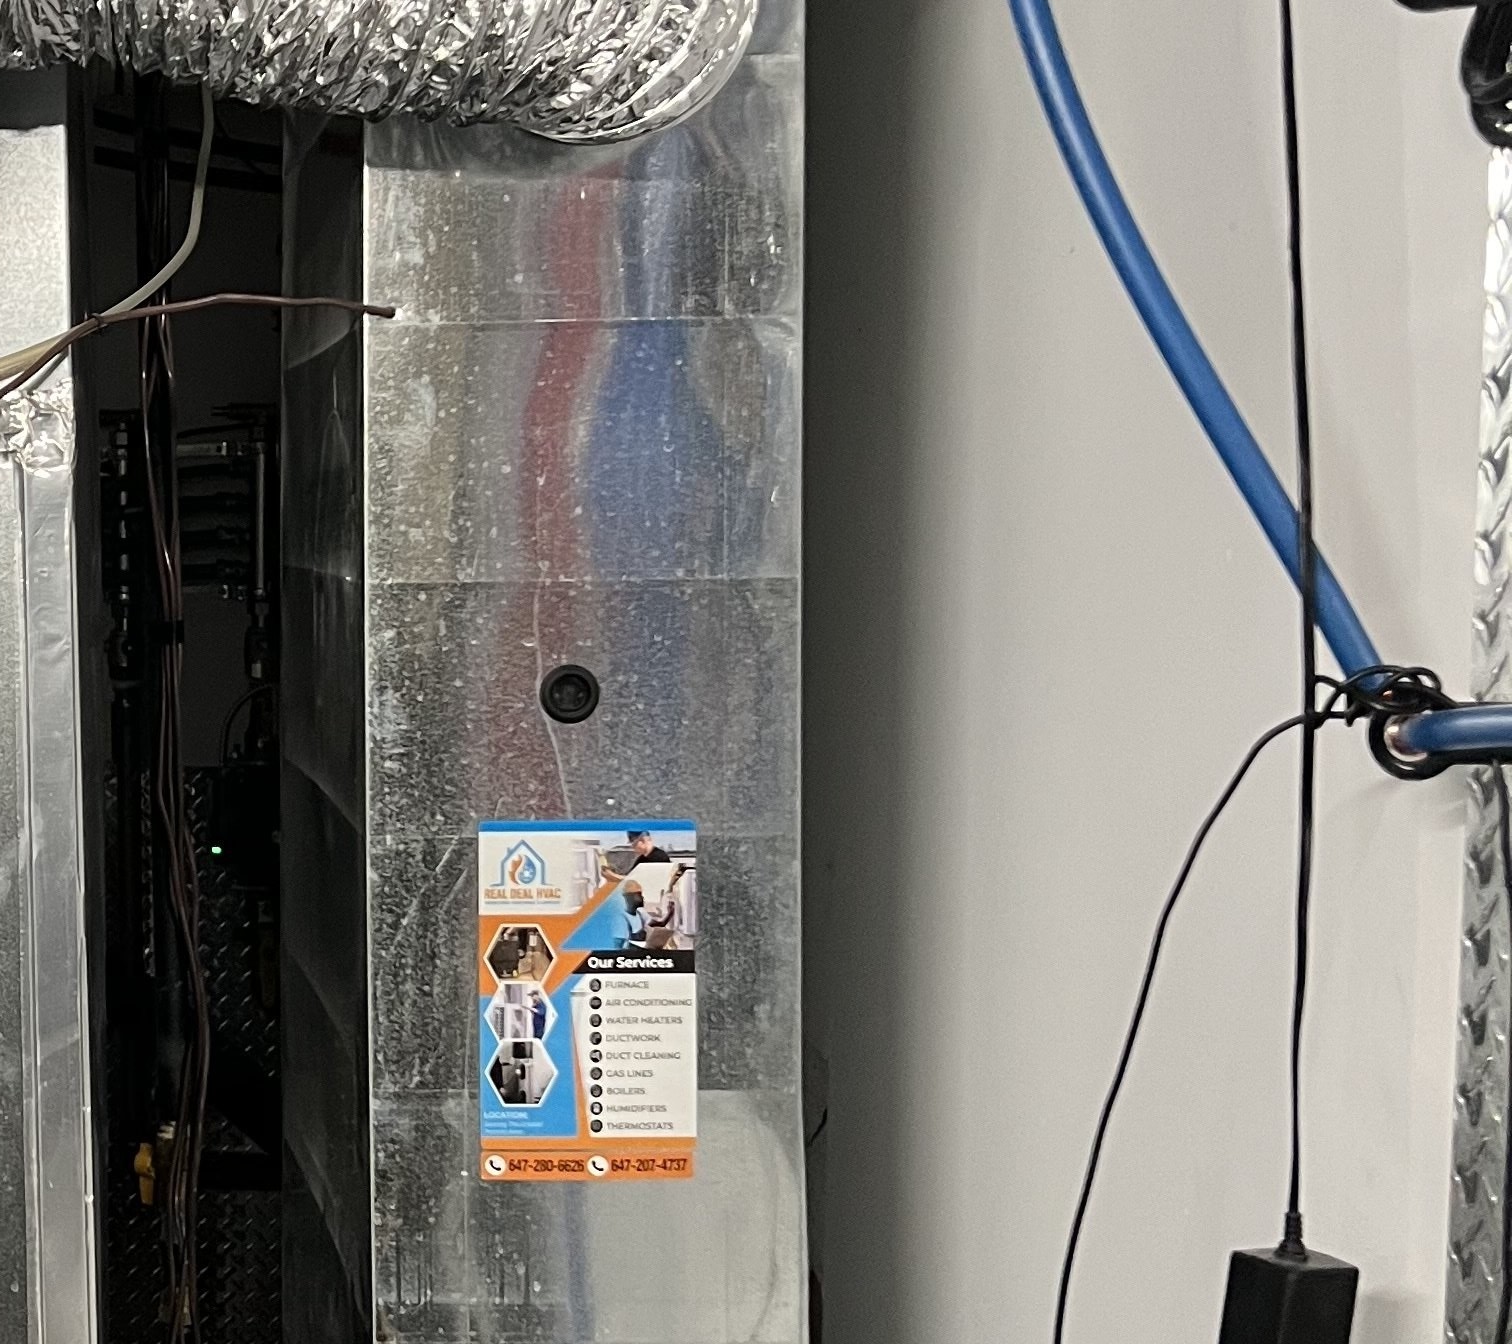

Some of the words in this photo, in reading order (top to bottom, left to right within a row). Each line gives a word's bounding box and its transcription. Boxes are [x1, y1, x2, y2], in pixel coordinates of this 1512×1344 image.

[483, 888, 507, 899] REAL
[510, 888, 534, 899] DEAL
[536, 887, 561, 899] HVAC
[588, 956, 614, 969] Our
[616, 955, 674, 969] Services
[605, 981, 650, 989] FURNACE
[605, 998, 621, 1007] AIR
[623, 998, 693, 1007] CONDITIONING
[605, 1016, 639, 1025] WATER
[641, 1016, 683, 1025] HEATERS
[605, 1034, 662, 1043] DUCTWORK
[605, 1051, 631, 1060] DUCT
[633, 1051, 681, 1060] CLEANING
[605, 1069, 625, 1078] GAS
[627, 1069, 654, 1078] LINES
[606, 1087, 646, 1095] BOILERS
[606, 1104, 668, 1113] HUMIDIFIERS
[606, 1121, 674, 1130] THERMOSTATS
[611, 1158, 687, 1172] 647-207-4737
